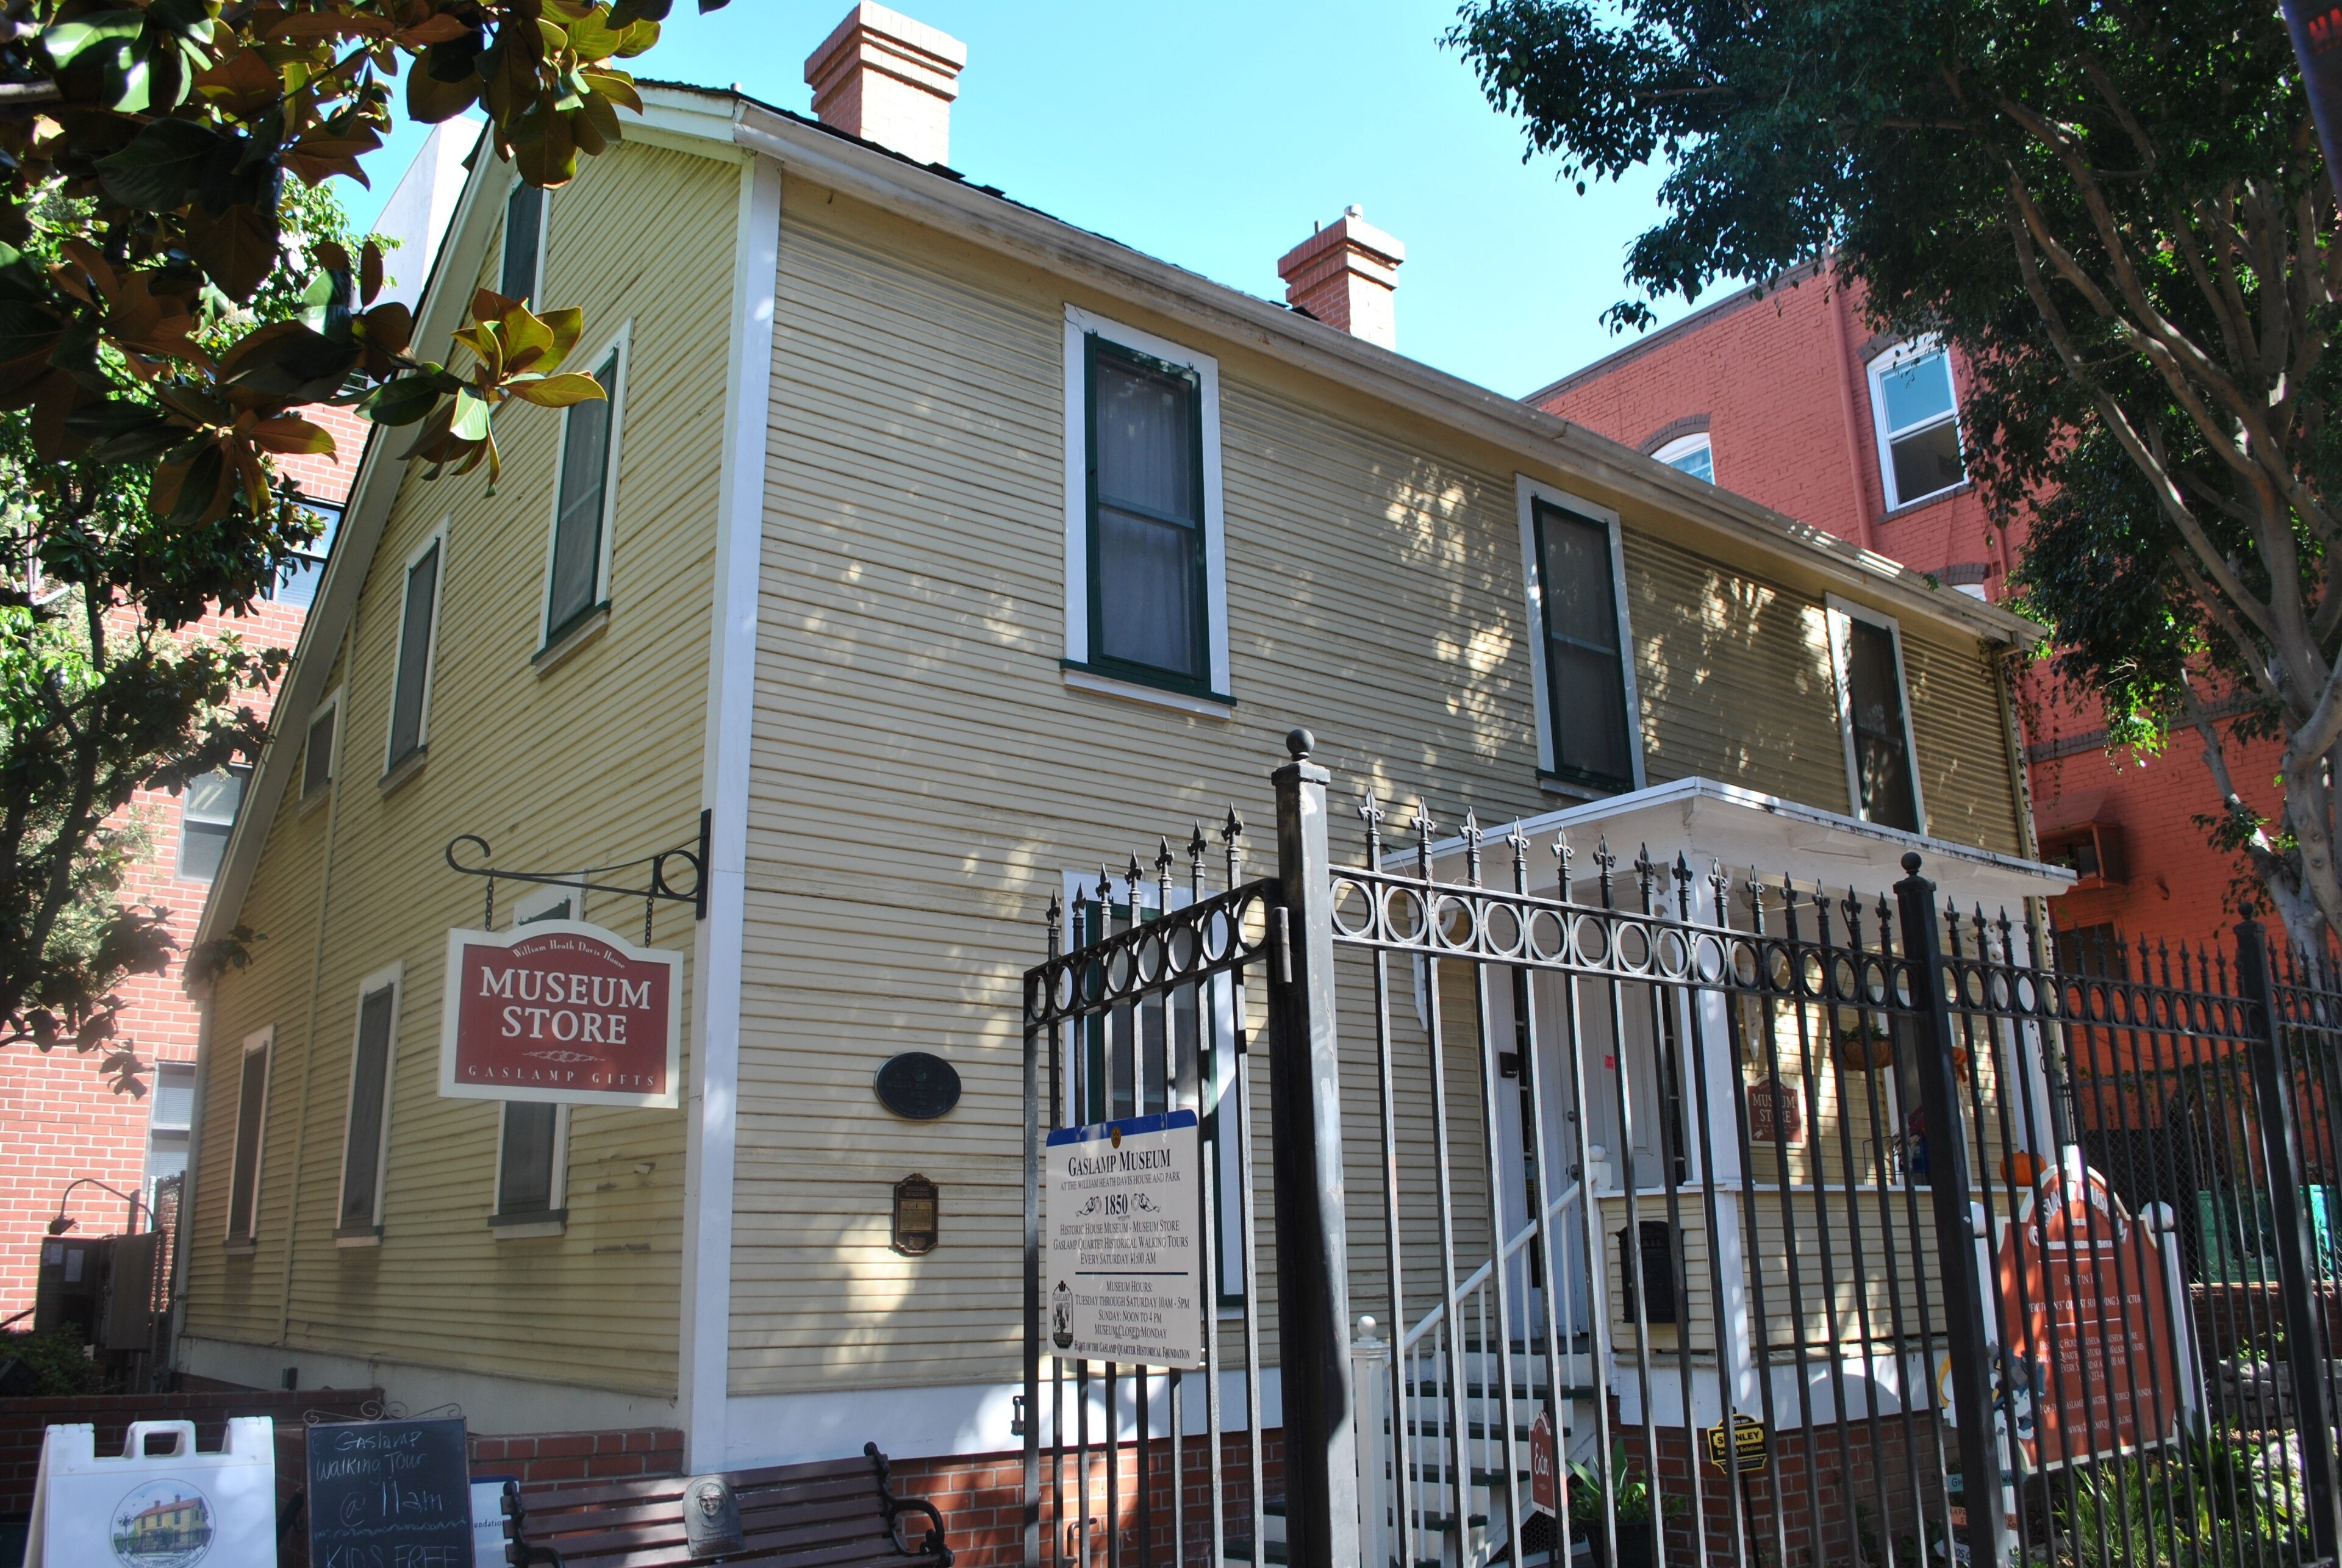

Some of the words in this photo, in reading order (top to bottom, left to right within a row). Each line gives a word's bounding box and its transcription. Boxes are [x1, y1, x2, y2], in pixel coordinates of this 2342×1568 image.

[512, 944, 546, 958] William
[550, 940, 574, 950] Heath
[578, 941, 600, 956] Davis
[603, 950, 625, 969] House
[479, 965, 651, 1010] MUSEUM
[501, 1005, 627, 1045] STORE
[468, 1065, 574, 1082] GASLAMP
[592, 1072, 654, 1086] GIFTS
[1752, 1094, 1795, 1108] MUSUM
[1760, 1109, 1791, 1123] STRE
[1068, 1155, 1115, 1176] GASLAMP
[1119, 1148, 1171, 1172] MUSEUM
[1067, 1181, 1076, 1190] THE
[1077, 1179, 1098, 1189] WILLIAM
[1099, 1177, 1115, 1187] HEATH
[1117, 1176, 1133, 1186] DAVIS
[1133, 1174, 1152, 1184] HOUSE
[1152, 1173, 1164, 1183] AND
[1165, 1171, 1180, 1181] PARK
[1104, 1194, 1128, 1215] 1850
[1060, 1224, 1084, 1235] HISTORIC
[1085, 1223, 1103, 1234] HOUSE
[1104, 1222, 1128, 1234] MUSEUM
[1133, 1221, 1159, 1233] MUSEUM
[1160, 1220, 1180, 1231] STORE
[1053, 1239, 1078, 1250] GASLAMP
[1078, 1238, 1103, 1250] QUARTER
[1105, 1237, 1137, 1248] HISTORICAL
[1139, 1236, 1166, 1248] WALKING
[1167, 1235, 1189, 1247] TOURS
[1081, 1253, 1098, 1264] EVERY
[1100, 1252, 1128, 1264] SATURDAY
[1145, 1251, 1156, 1264] AM
[1106, 1280, 1130, 1292] MUSEUM
[1131, 1281, 1153, 1293] HOURS:
[1075, 1294, 1098, 1306] TUESDAY
[1100, 1295, 1126, 1308] THROUGH
[1126, 1295, 1157, 1308] SATURDAY
[1159, 1296, 1173, 1308] 10AM
[1178, 1297, 1189, 1309] 5PM
[1098, 1309, 1122, 1322] SUNDAY:
[1123, 1310, 1139, 1322] NOON
[1141, 1312, 1148, 1322] TO
[1153, 1312, 1162, 1323] PM
[1141, 1326, 1167, 1339] MONDAY
[1075, 1340, 1085, 1350] HOME
[1086, 1341, 1092, 1351] OF
[1100, 1342, 1116, 1353] GASLAMP
[1117, 1344, 1136, 1356] QUARTER
[1137, 1344, 1161, 1357] HISTORICAL
[1162, 1346, 1190, 1359] FOUNDATION
[2035, 1353, 2051, 1363] GASLA
[2132, 1342, 2144, 1351] OURS
[2066, 1398, 2083, 1409] ASLAMP
[1717, 1431, 1759, 1444] SNLEY
[340, 1492, 365, 1527] @
